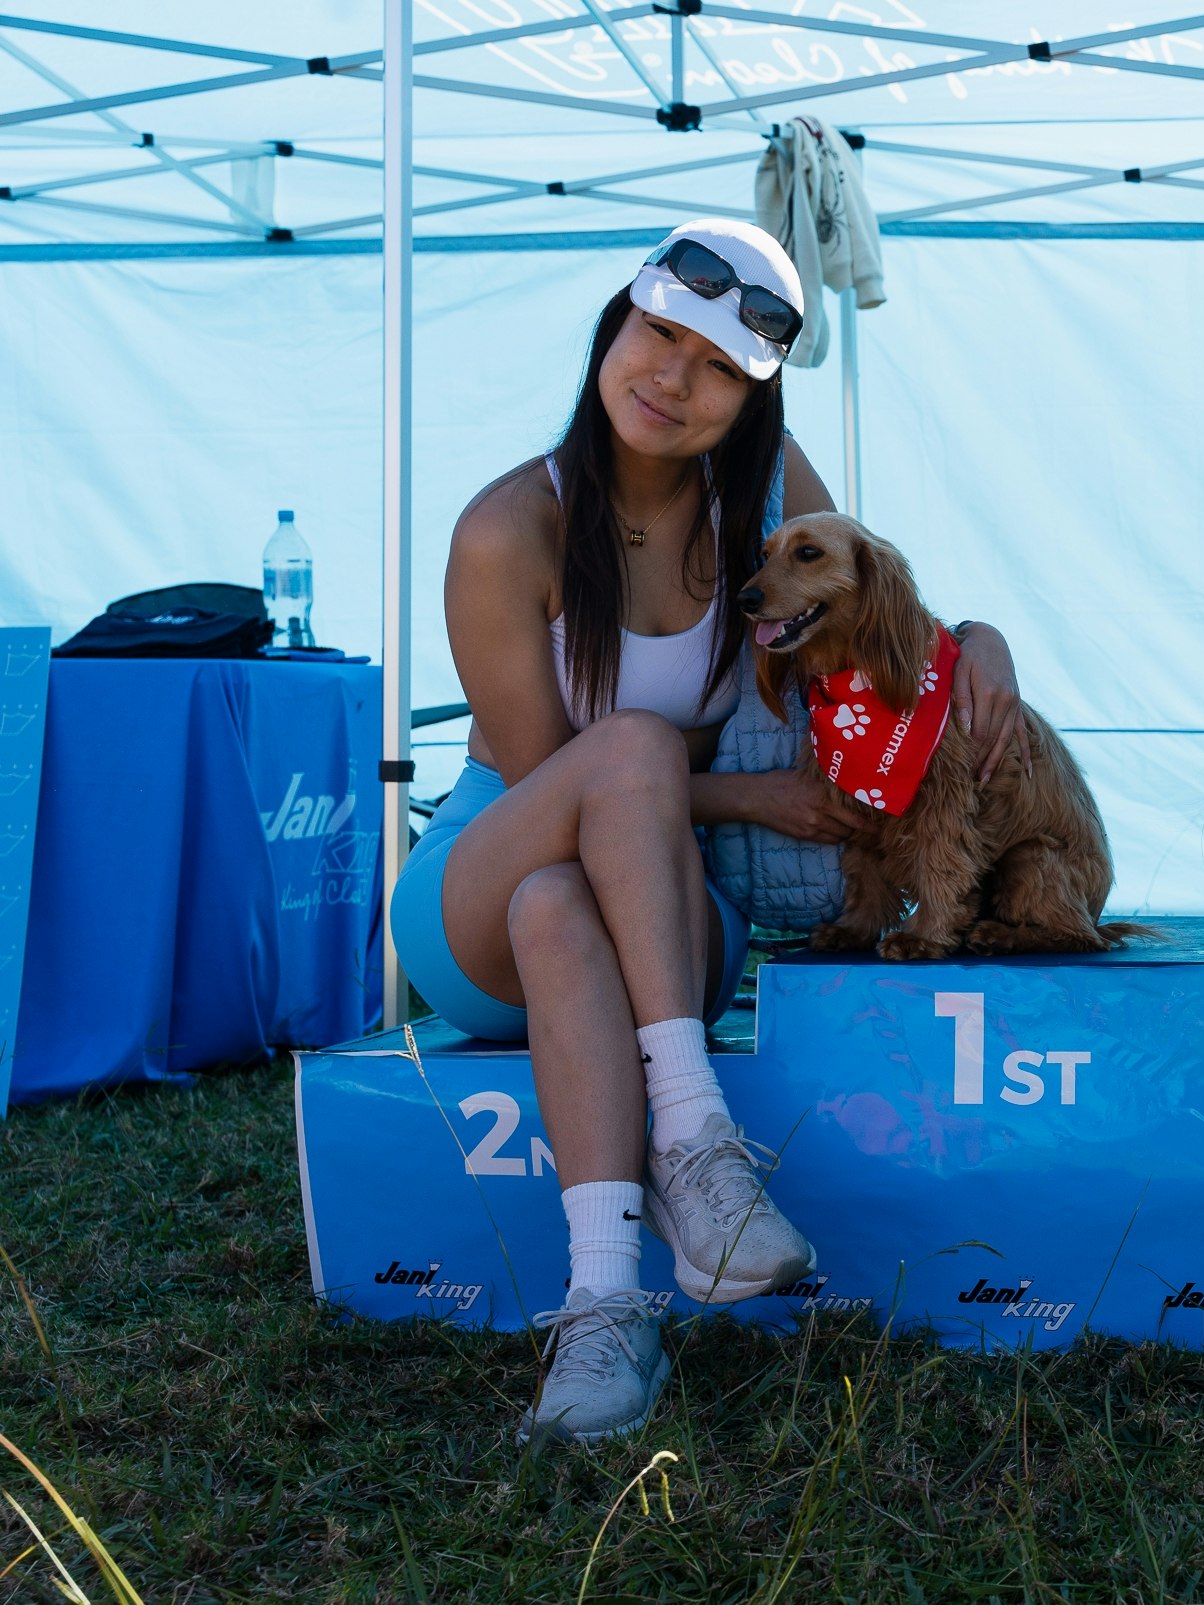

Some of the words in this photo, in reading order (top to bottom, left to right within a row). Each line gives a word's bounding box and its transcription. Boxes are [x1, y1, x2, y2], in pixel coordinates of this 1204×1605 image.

[934, 992, 1092, 1106] 1ST
[458, 1091, 557, 1177] 2N
[374, 1260, 444, 1285] Jani
[761, 1275, 830, 1297] ani
[958, 1278, 1034, 1303] Jani
